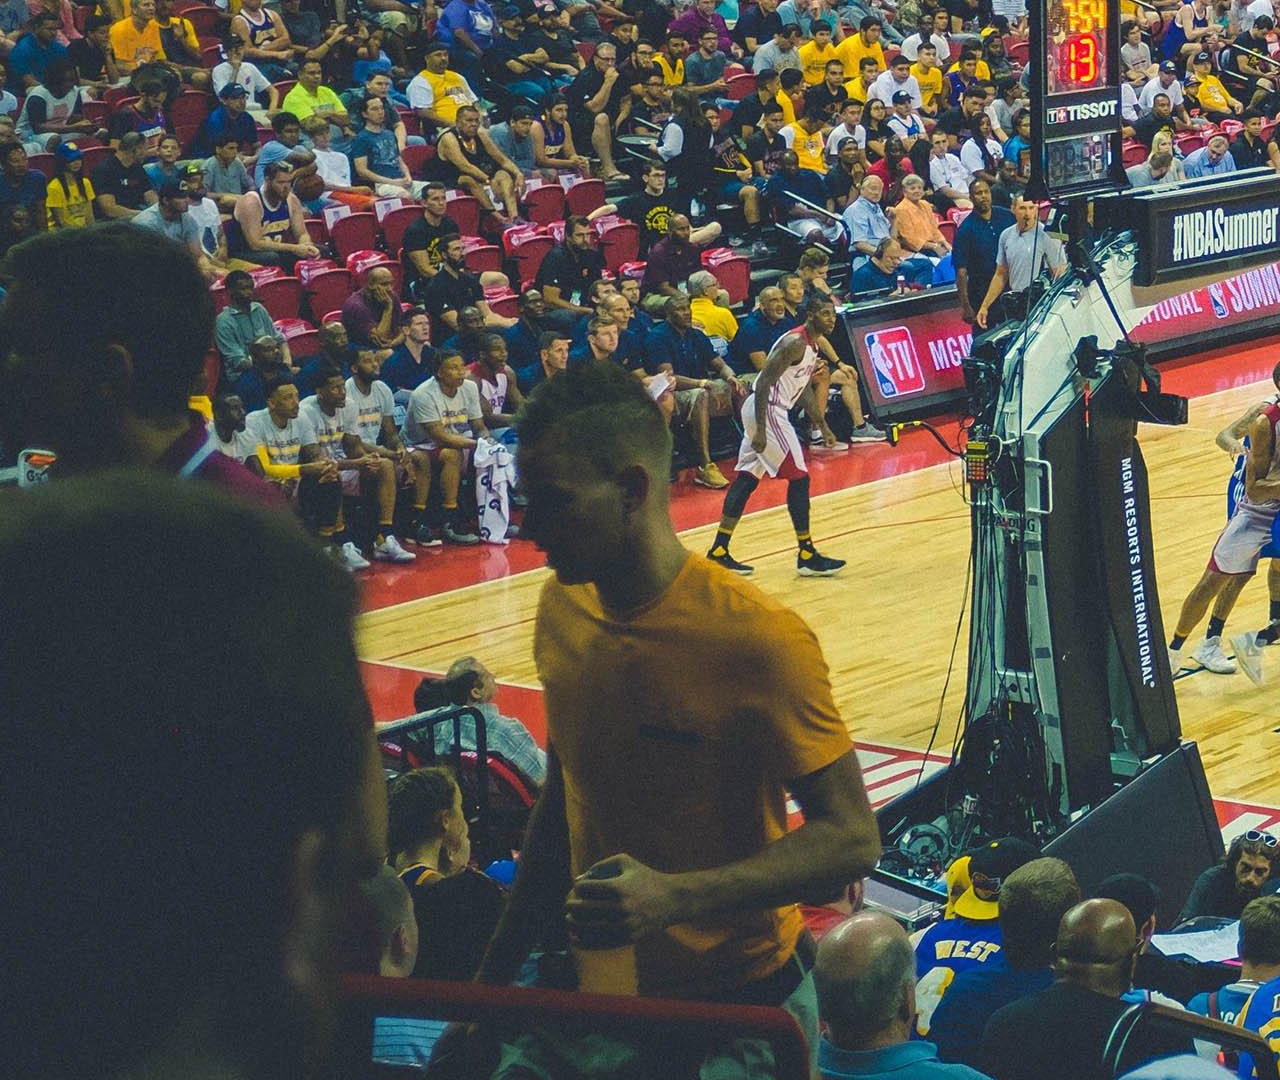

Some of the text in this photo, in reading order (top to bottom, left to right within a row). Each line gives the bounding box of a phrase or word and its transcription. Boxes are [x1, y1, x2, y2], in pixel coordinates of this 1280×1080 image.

[1069, 37, 1096, 82] 13
[1068, 100, 1118, 122] TISSOT
[1172, 207, 1279, 261] #NBASummer
[887, 340, 915, 381] TV
[928, 333, 973, 371] MGM
[1120, 457, 1155, 687] MGM RESORTS INTERNATIONAL
[934, 939, 1000, 963] WEST
